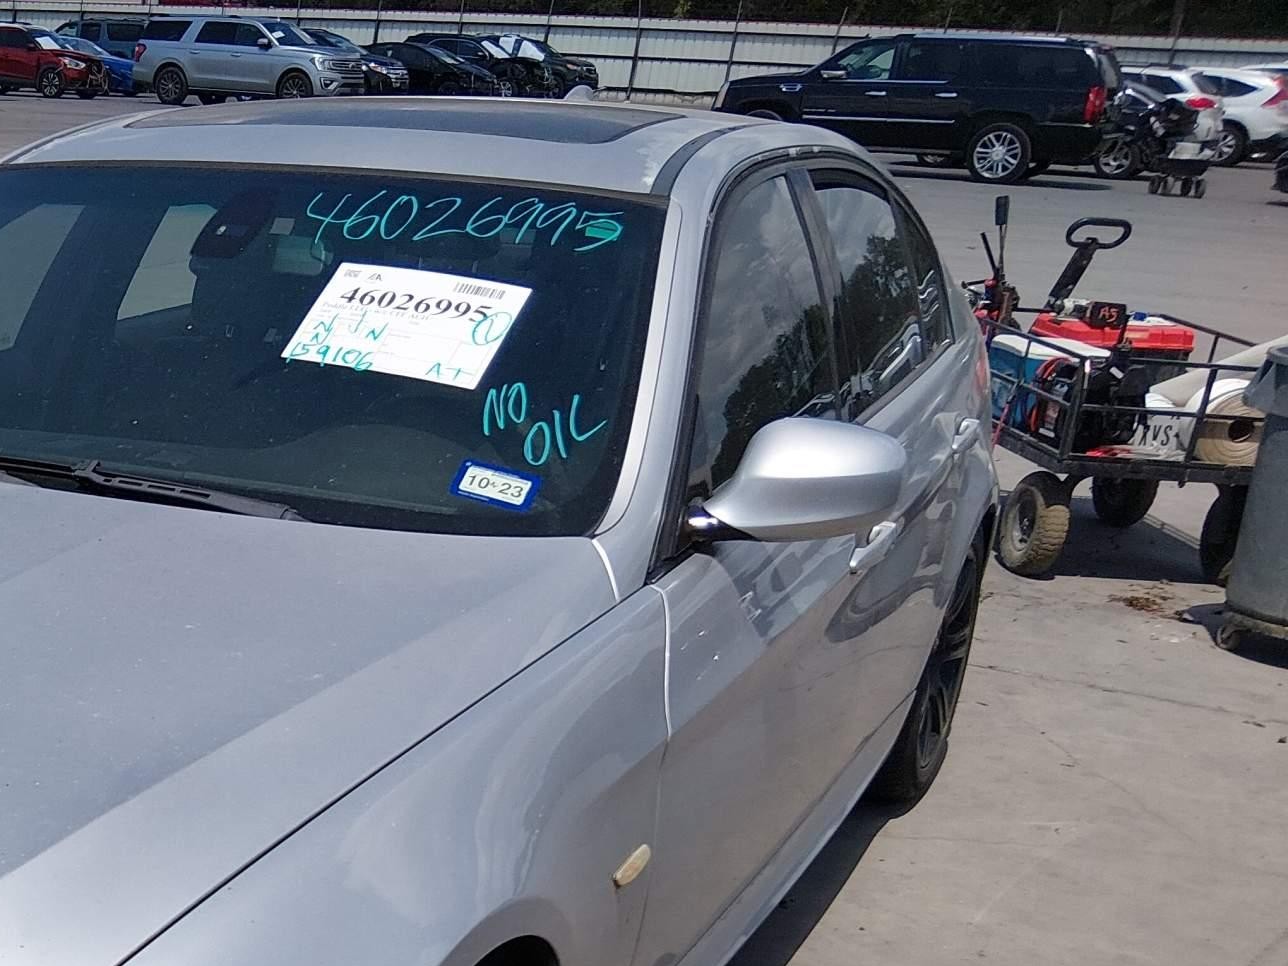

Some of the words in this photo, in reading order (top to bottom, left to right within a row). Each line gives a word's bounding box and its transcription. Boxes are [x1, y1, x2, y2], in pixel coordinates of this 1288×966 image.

[306, 190, 625, 252] 46026995
[340, 286, 492, 322] 46026995
[483, 382, 527, 436] NO
[524, 394, 608, 466] OIL
